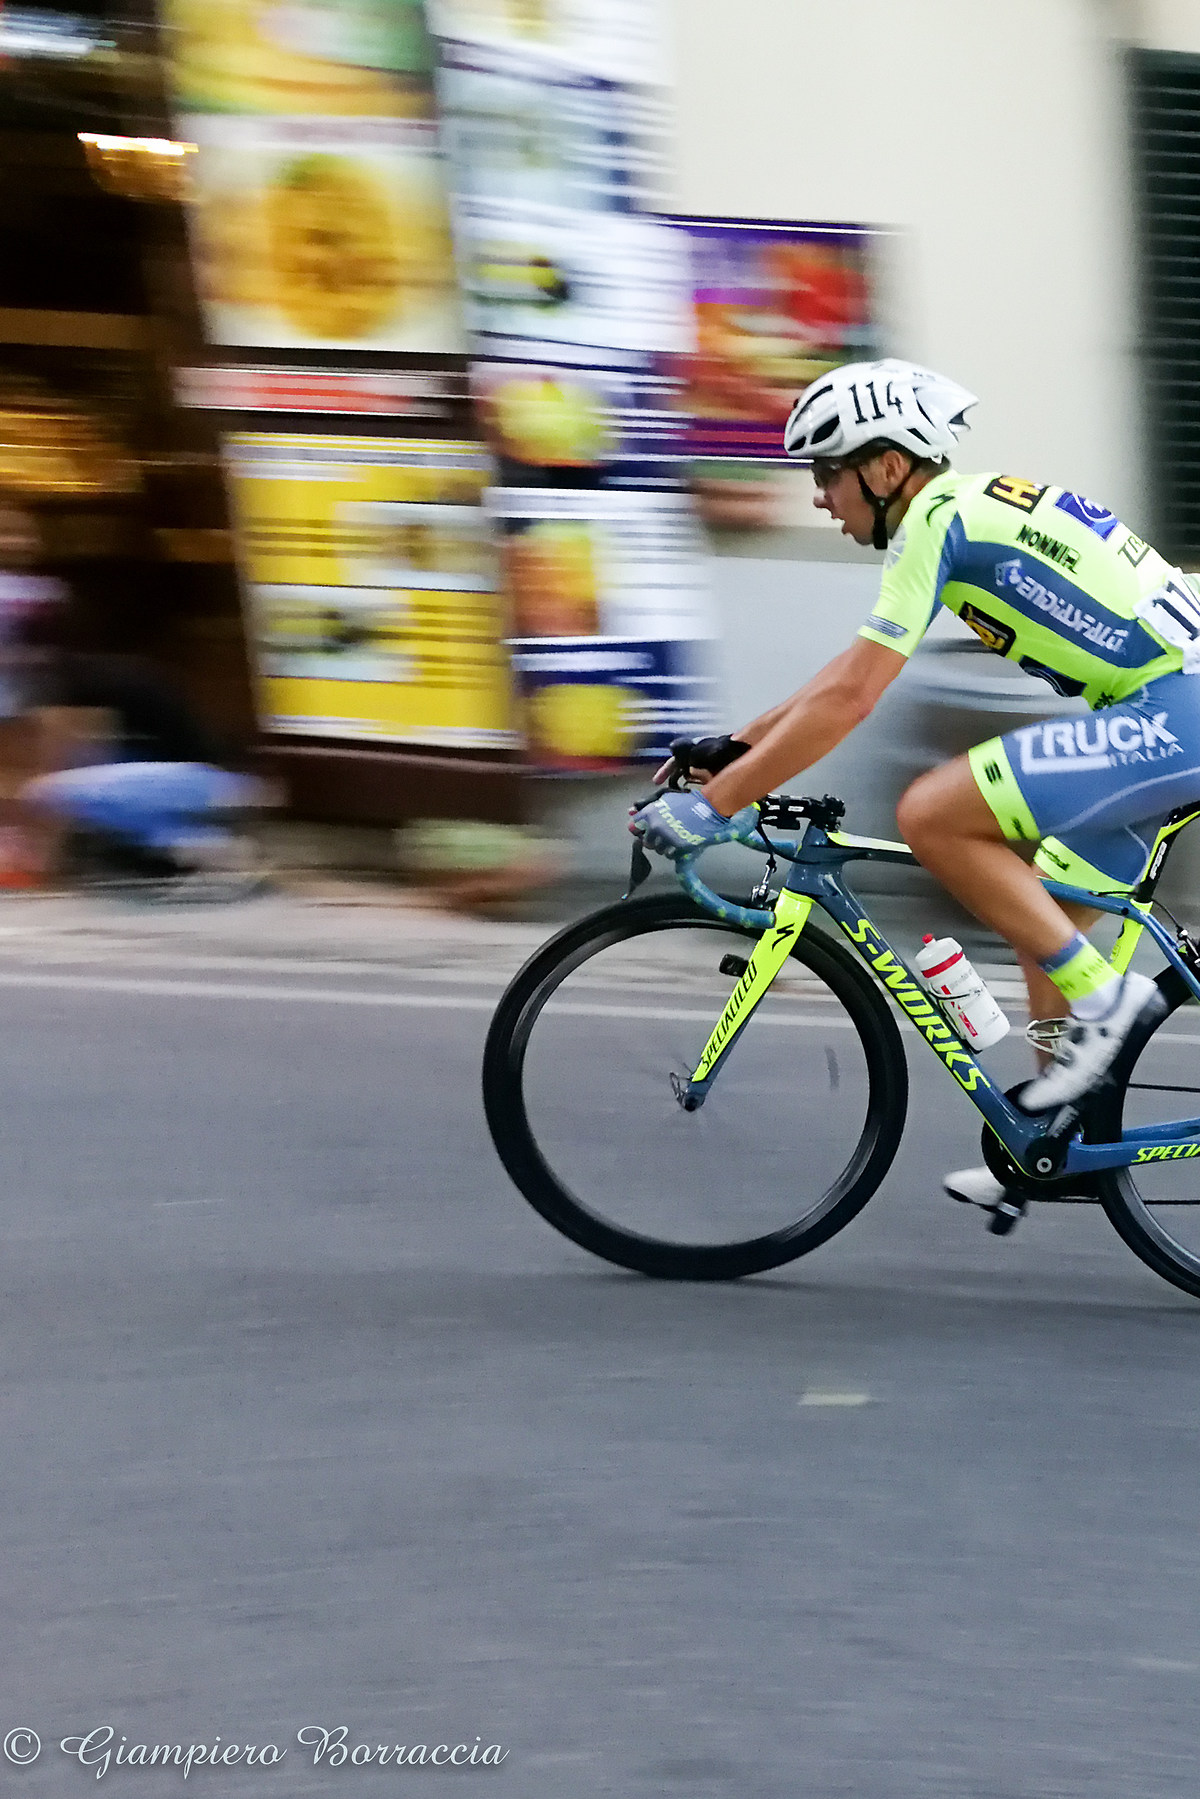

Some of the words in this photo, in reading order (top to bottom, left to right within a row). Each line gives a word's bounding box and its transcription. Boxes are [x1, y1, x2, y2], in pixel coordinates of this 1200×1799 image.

[849, 380, 903, 424] 114
[1014, 710, 1180, 775] TRUCK
[1108, 742, 1185, 767] ITALIA
[701, 959, 759, 1073] SPECIALIZED
[840, 918, 992, 1092] S-WORKS
